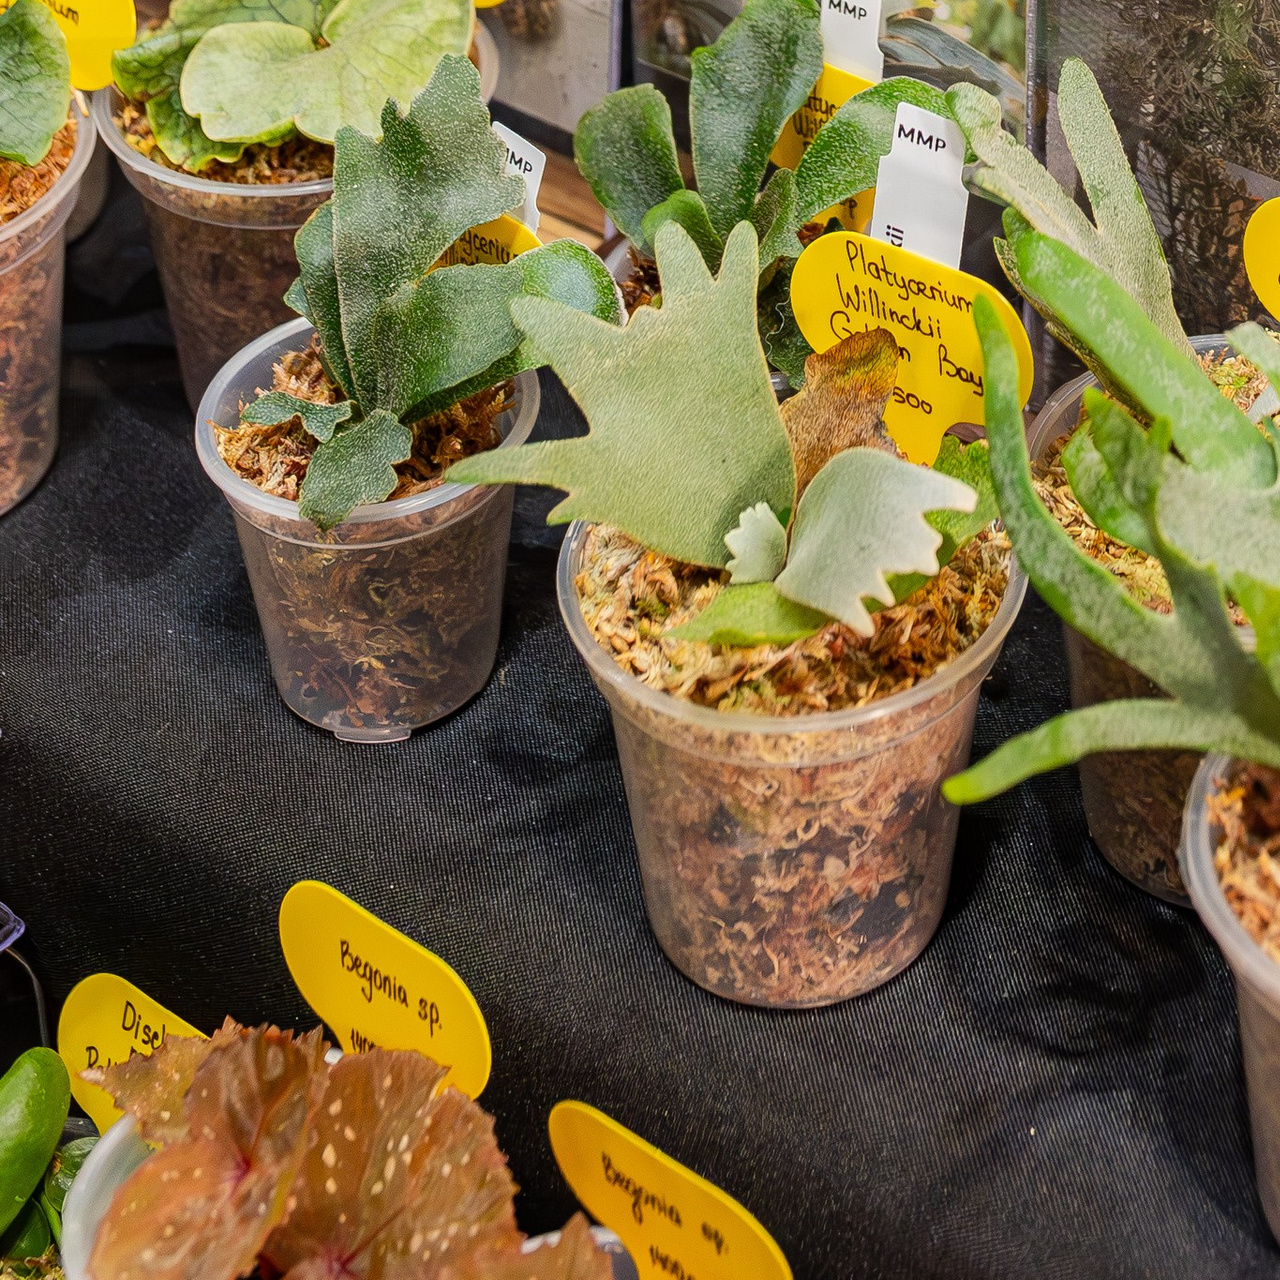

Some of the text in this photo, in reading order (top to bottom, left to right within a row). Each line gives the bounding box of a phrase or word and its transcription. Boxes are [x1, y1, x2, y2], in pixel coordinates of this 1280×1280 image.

[505, 147, 533, 175] MP
[897, 123, 948, 153] MMP
[835, 272, 942, 340] Willinckii
[845, 239, 975, 314] Platycerium
[893, 385, 933, 415] 500
[938, 343, 984, 397] Boy
[339, 940, 443, 1039] Begonia sp.
[601, 1150, 683, 1226] Begonia
